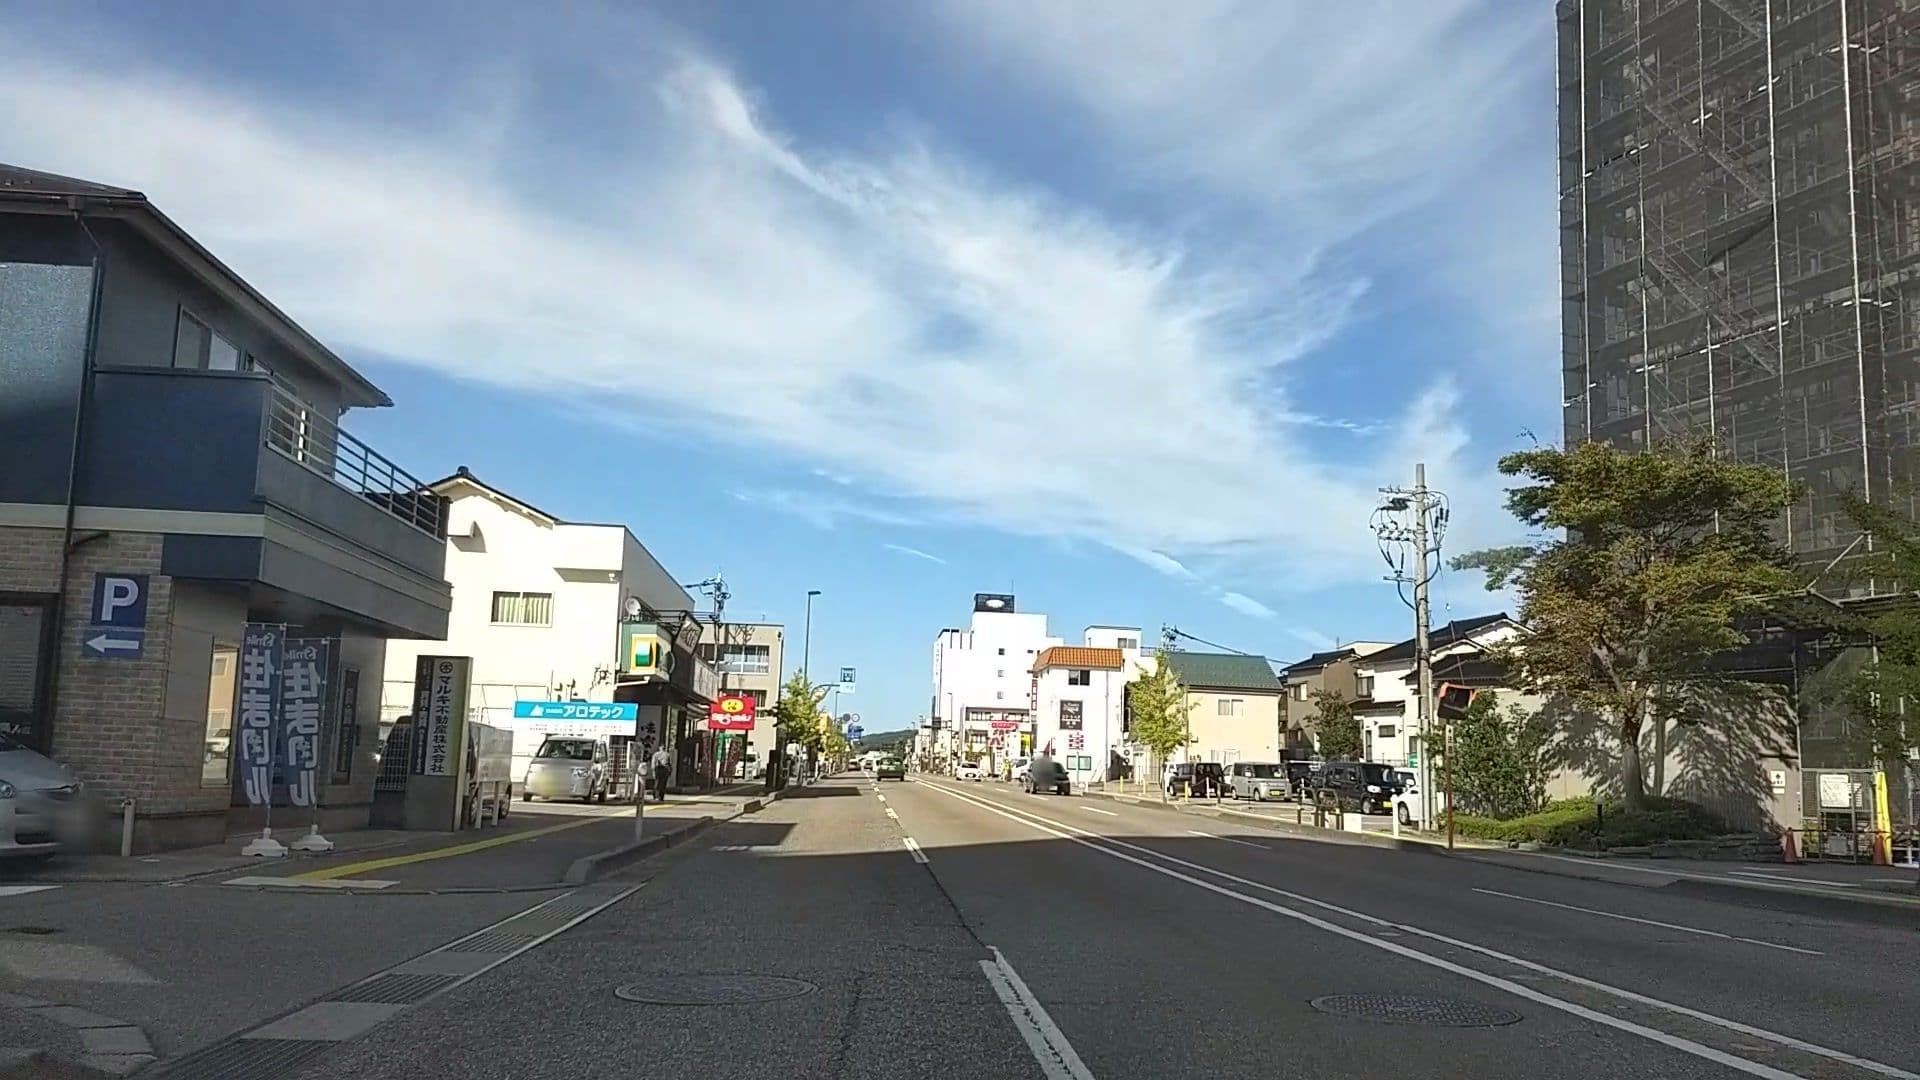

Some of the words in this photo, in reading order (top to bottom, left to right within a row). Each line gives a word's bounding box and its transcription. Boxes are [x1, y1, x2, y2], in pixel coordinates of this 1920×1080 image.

[101, 577, 139, 621] P
[563, 705, 624, 719] アロテック
